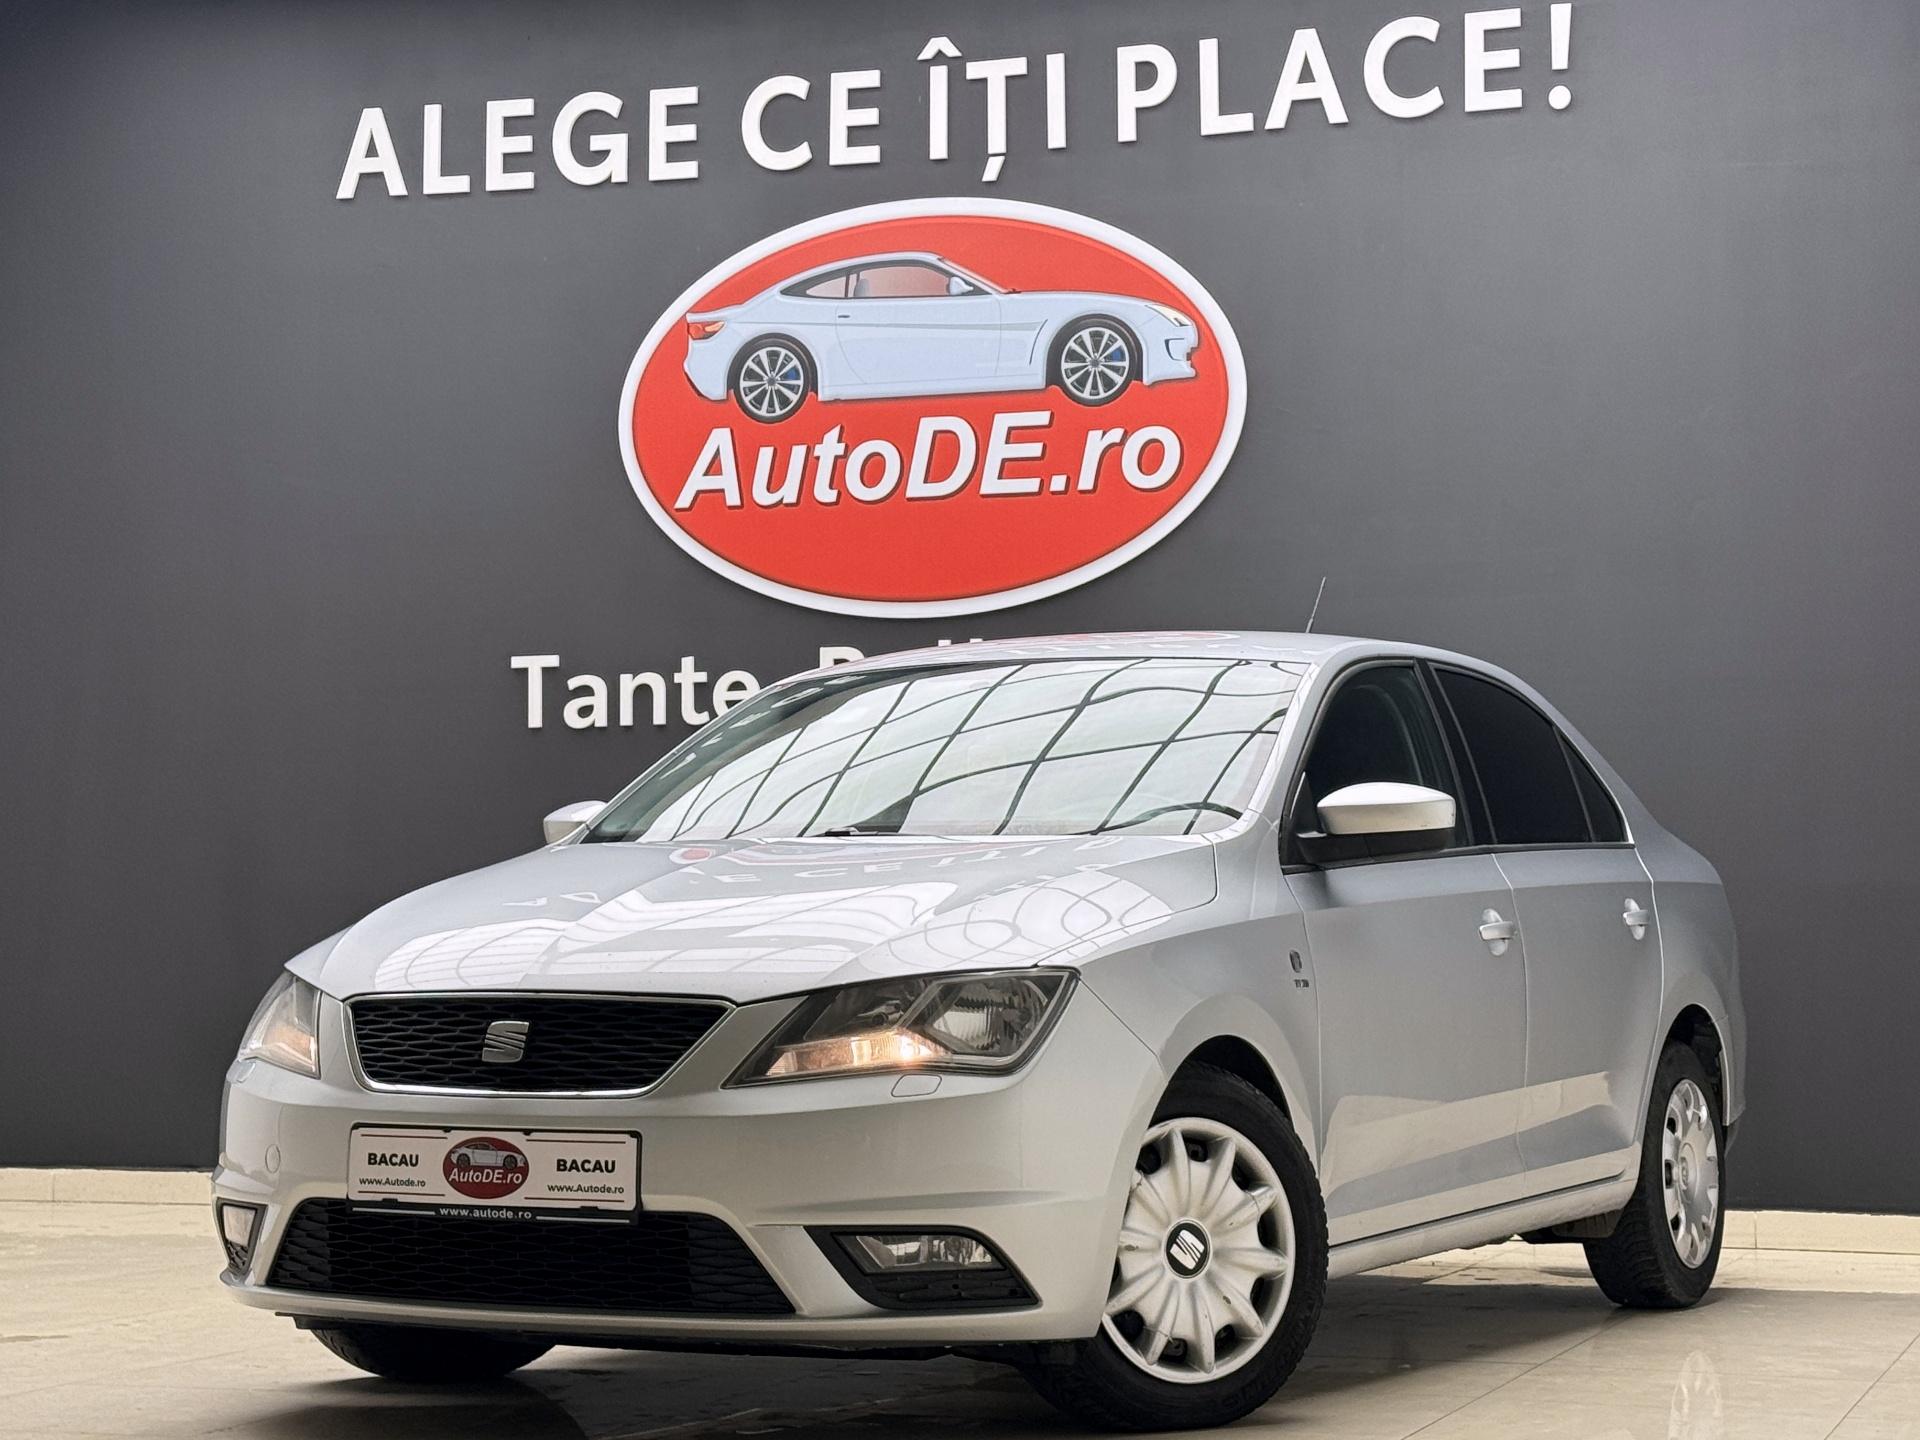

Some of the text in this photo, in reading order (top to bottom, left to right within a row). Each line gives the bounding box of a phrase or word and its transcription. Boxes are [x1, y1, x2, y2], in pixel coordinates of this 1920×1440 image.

[336, 86, 699, 199] ALEGE
[741, 69, 880, 171] CE
[1116, 2, 1572, 143] PLACE!
[673, 410, 1183, 511] AutoDE.ro
[510, 654, 762, 729] Tante
[367, 1152, 419, 1167] BACAU
[556, 1158, 616, 1173] BACAU
[359, 1177, 426, 1187] www.Autode.ro
[449, 1167, 522, 1184] AutoDE.ro
[547, 1184, 625, 1194] www.Autode.ro
[439, 1206, 532, 1219] www.autode.ro
